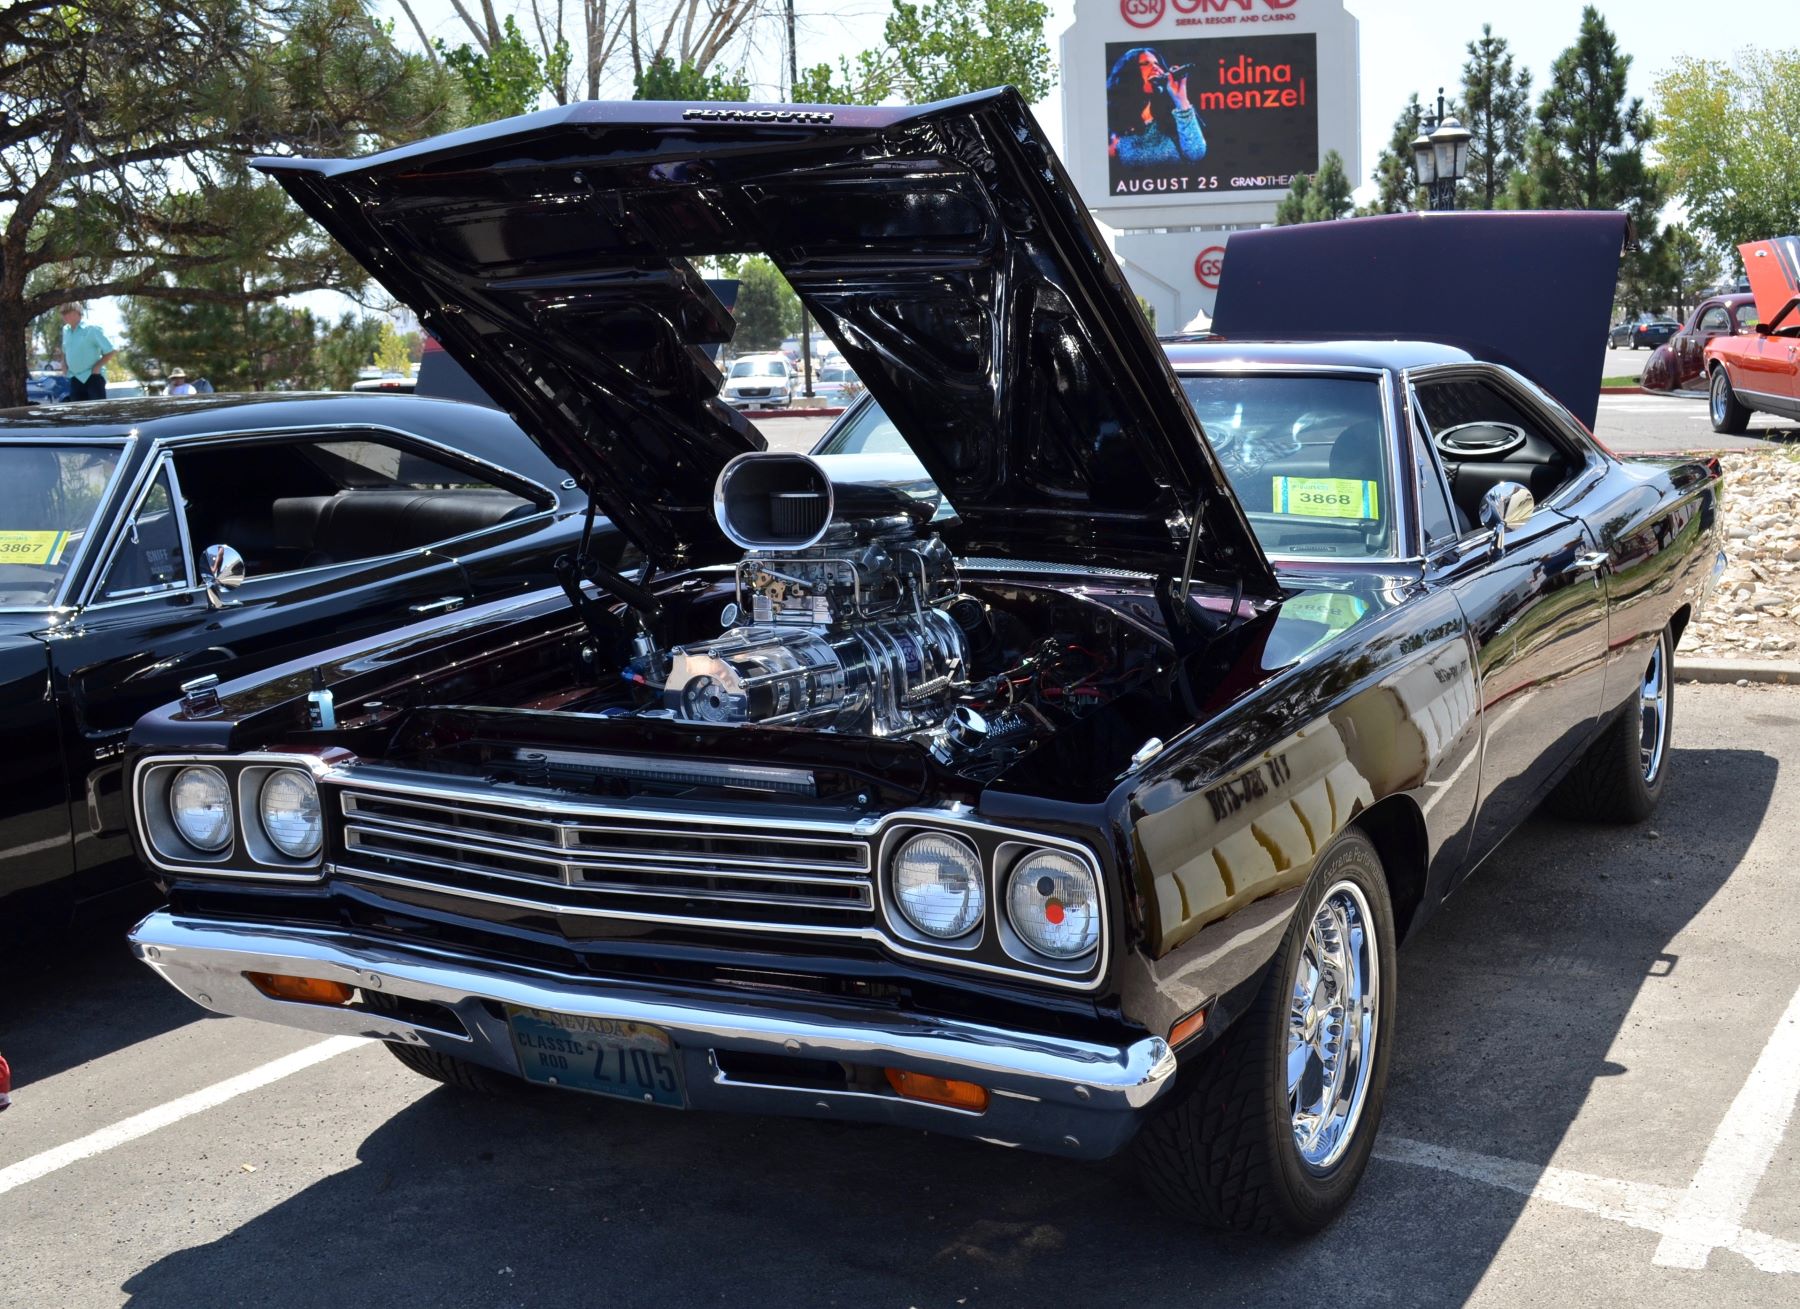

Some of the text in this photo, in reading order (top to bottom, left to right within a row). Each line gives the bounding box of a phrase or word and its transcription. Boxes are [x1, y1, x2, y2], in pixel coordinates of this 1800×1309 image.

[1126, 0, 1159, 14] GSR
[1175, 13, 1296, 26] SIERRA RESORT AND CASINO
[1218, 55, 1291, 85] idina
[1200, 77, 1305, 110] menzel
[682, 109, 834, 124] PLYMOUTH
[1116, 177, 1189, 193] AUGUST
[1198, 176, 1219, 189] 25
[1200, 259, 1221, 276] GS
[1300, 492, 1351, 505] 3868
[0, 543, 43, 553] 3867
[551, 1010, 625, 1036] NEVADA
[518, 1032, 584, 1055] CLASSIC
[588, 1040, 676, 1092] 2705
[538, 1052, 569, 1070] ROD
